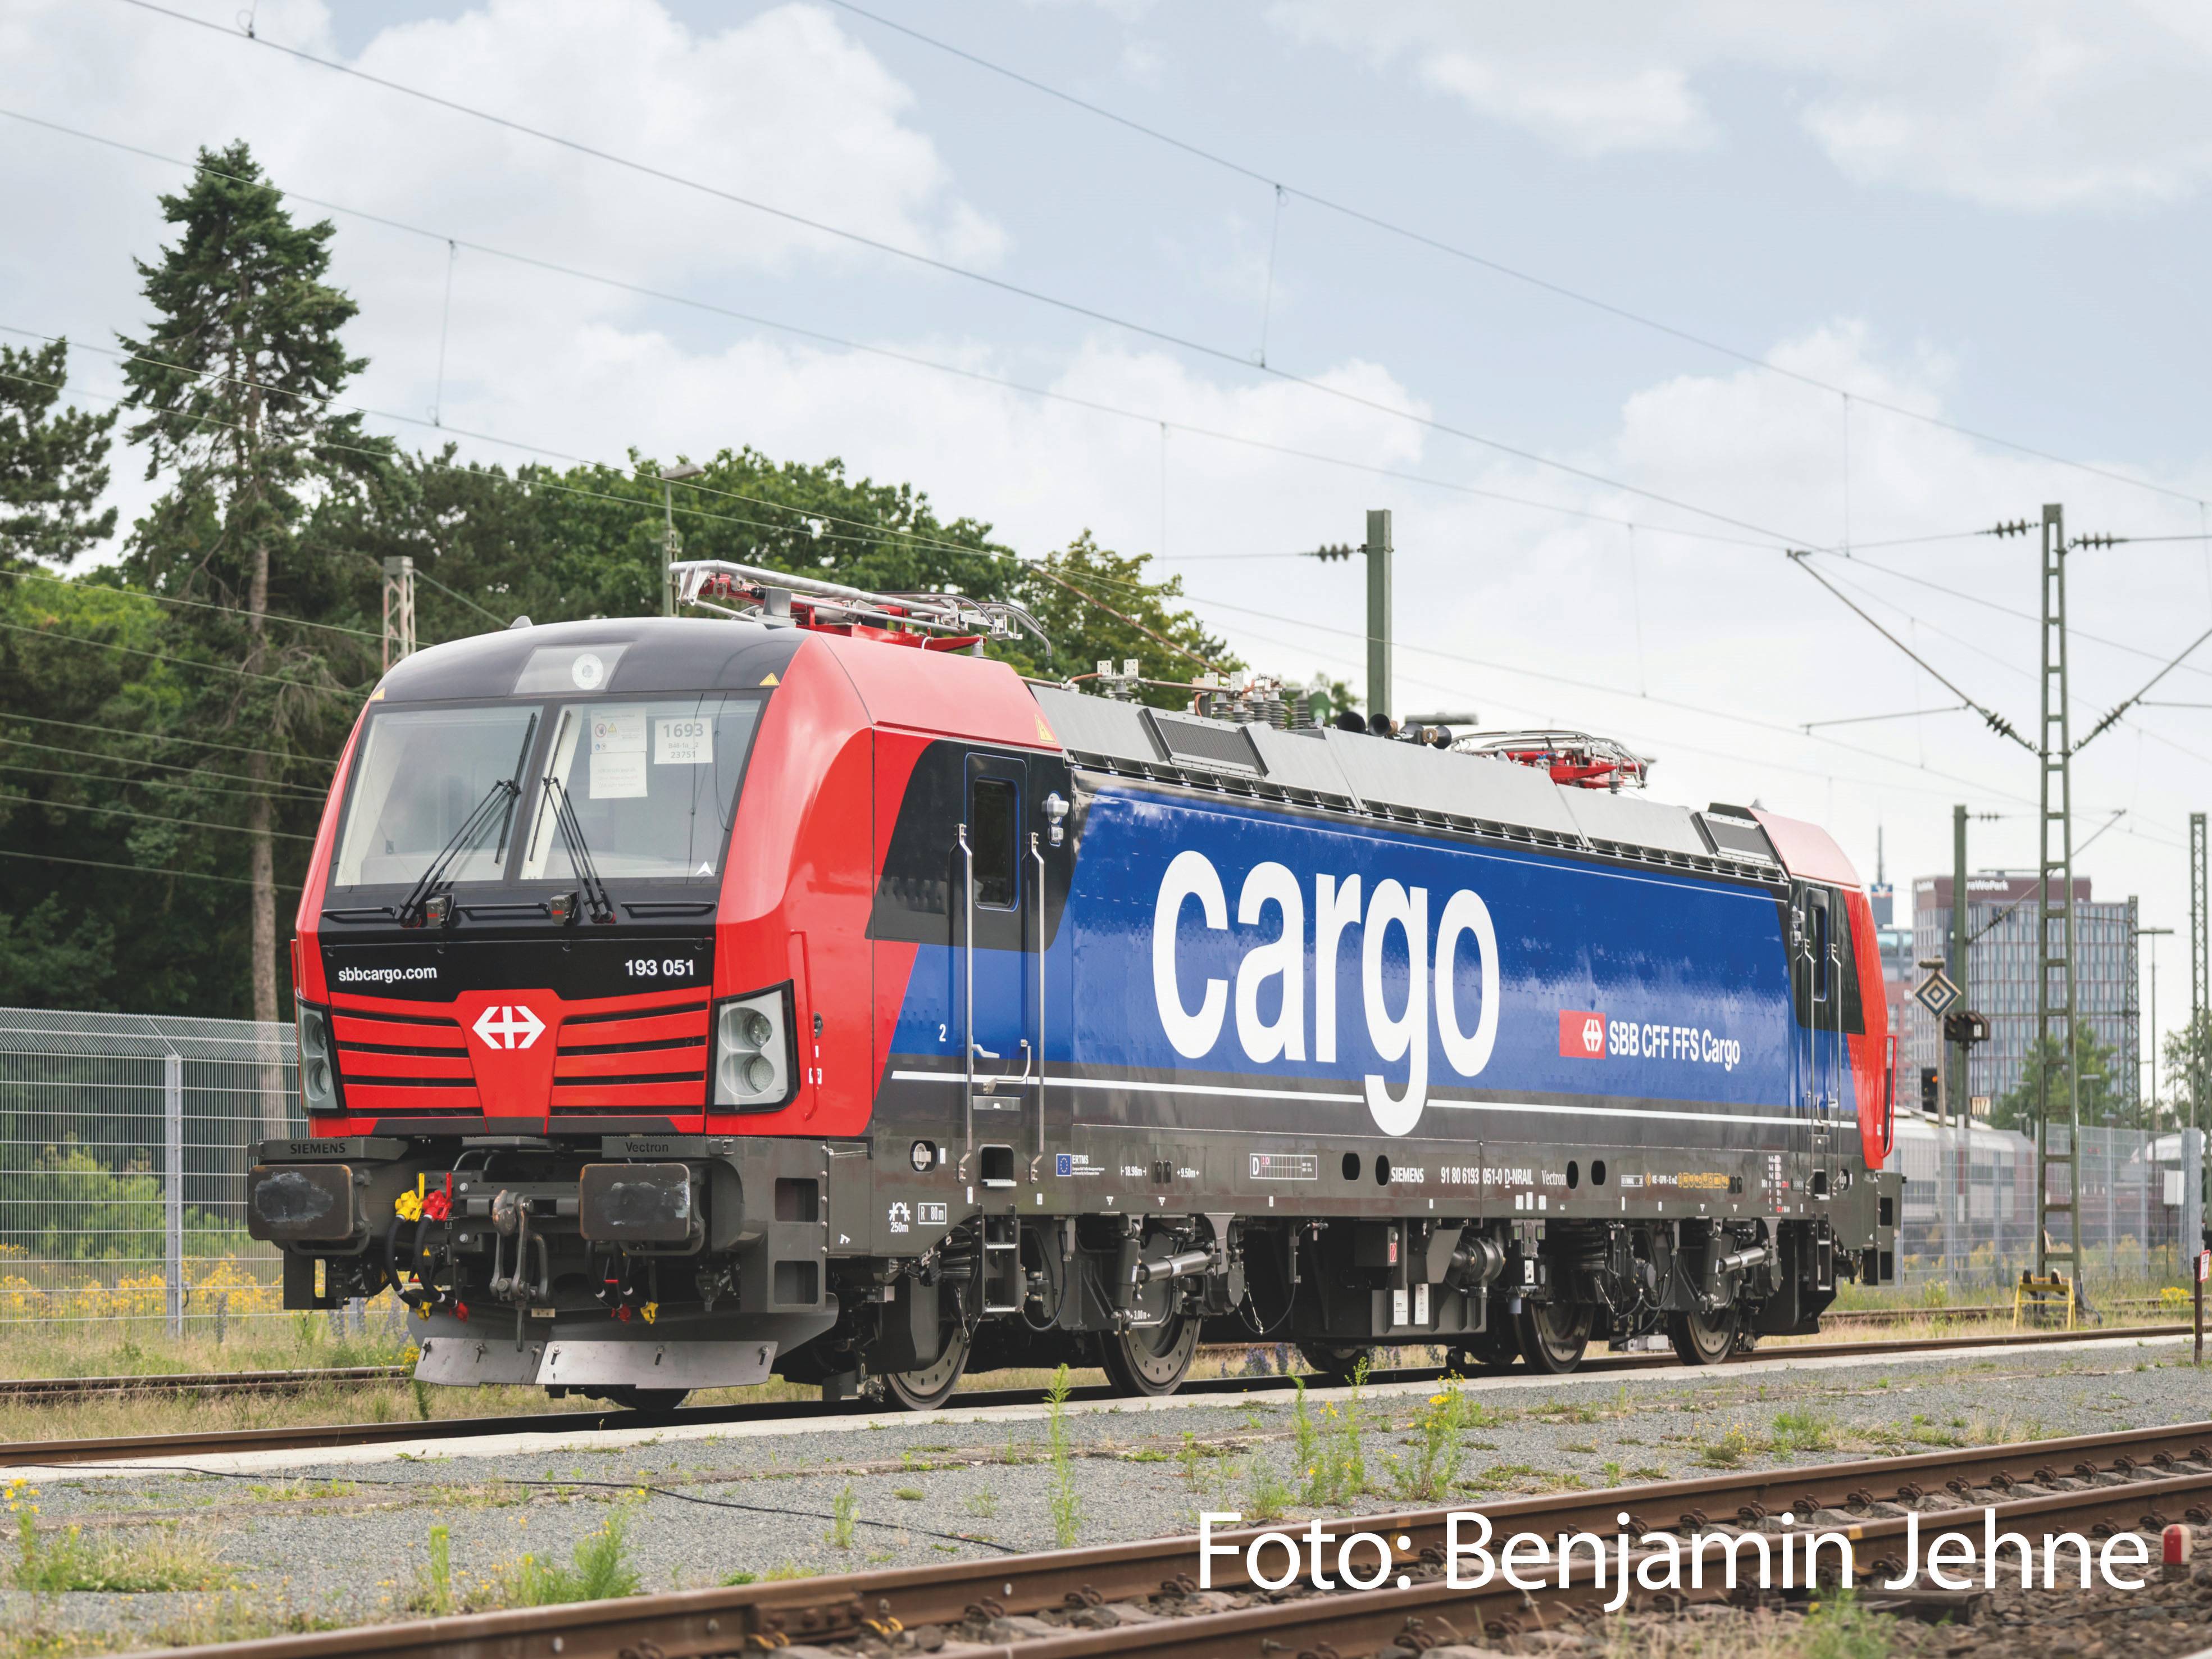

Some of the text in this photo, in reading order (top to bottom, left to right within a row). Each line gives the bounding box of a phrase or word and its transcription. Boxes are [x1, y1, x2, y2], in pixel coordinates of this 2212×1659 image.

[663, 723, 703, 737] 1693
[338, 967, 437, 983] sbbcargo.com
[625, 960, 694, 976] 193 051
[1153, 850, 1500, 1137] cargo
[939, 1024, 946, 1042] 2
[1609, 1020, 1740, 1072] SBB CFF FFS Cargo
[290, 1143, 346, 1154] SIEMENS
[625, 1142, 669, 1152] Vectron
[1072, 1155, 1089, 1164] ERTMS
[1253, 1157, 1259, 1175] D
[1391, 1167, 1424, 1183] SIEMENS
[1441, 1167, 1533, 1185] 91 80 6193 051-0 D-NRAIL
[1541, 1170, 1567, 1185] Vectron
[921, 1206, 925, 1220] R
[890, 1222, 909, 1233] 250m
